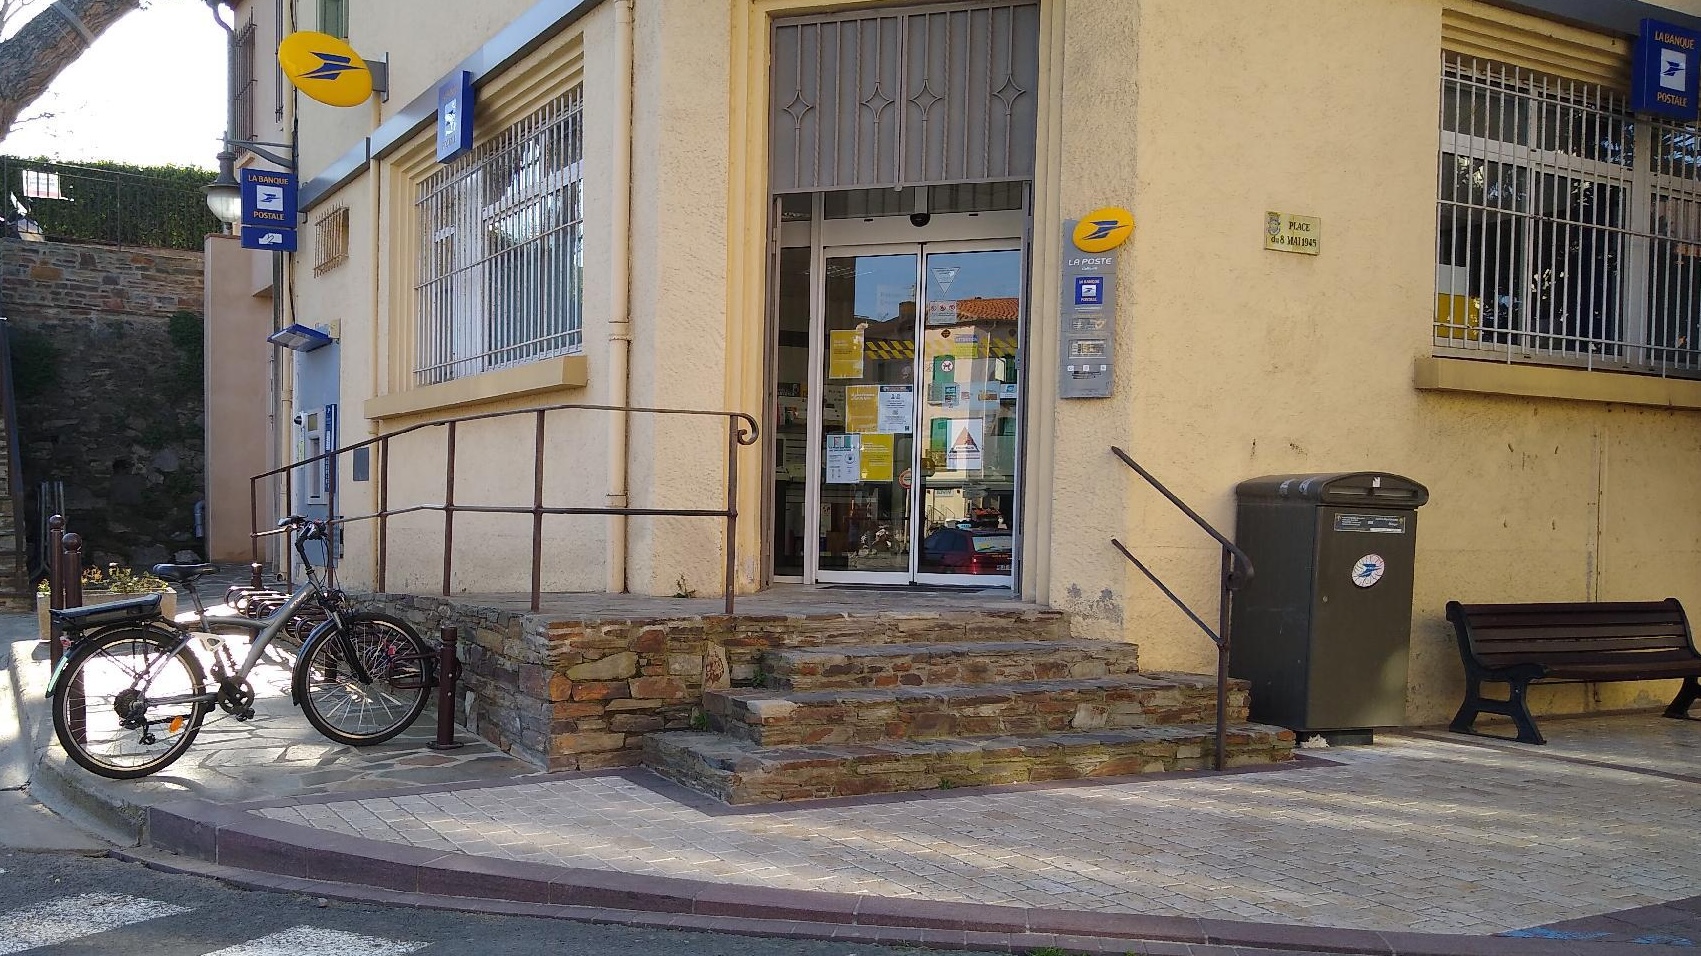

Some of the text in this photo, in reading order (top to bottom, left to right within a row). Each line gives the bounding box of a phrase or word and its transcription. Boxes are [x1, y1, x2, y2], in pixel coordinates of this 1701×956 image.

[1654, 30, 1695, 49] LA BANQUE
[1657, 91, 1688, 107] POSTALE
[248, 174, 289, 185] LA BANQUE
[253, 211, 285, 220] POSTALE
[1289, 221, 1311, 231] PLACE
[1279, 235, 1285, 244] 8
[1287, 236, 1301, 246] MAI
[1301, 237, 1317, 247] 1945
[1068, 257, 1112, 266] LA POSTE
